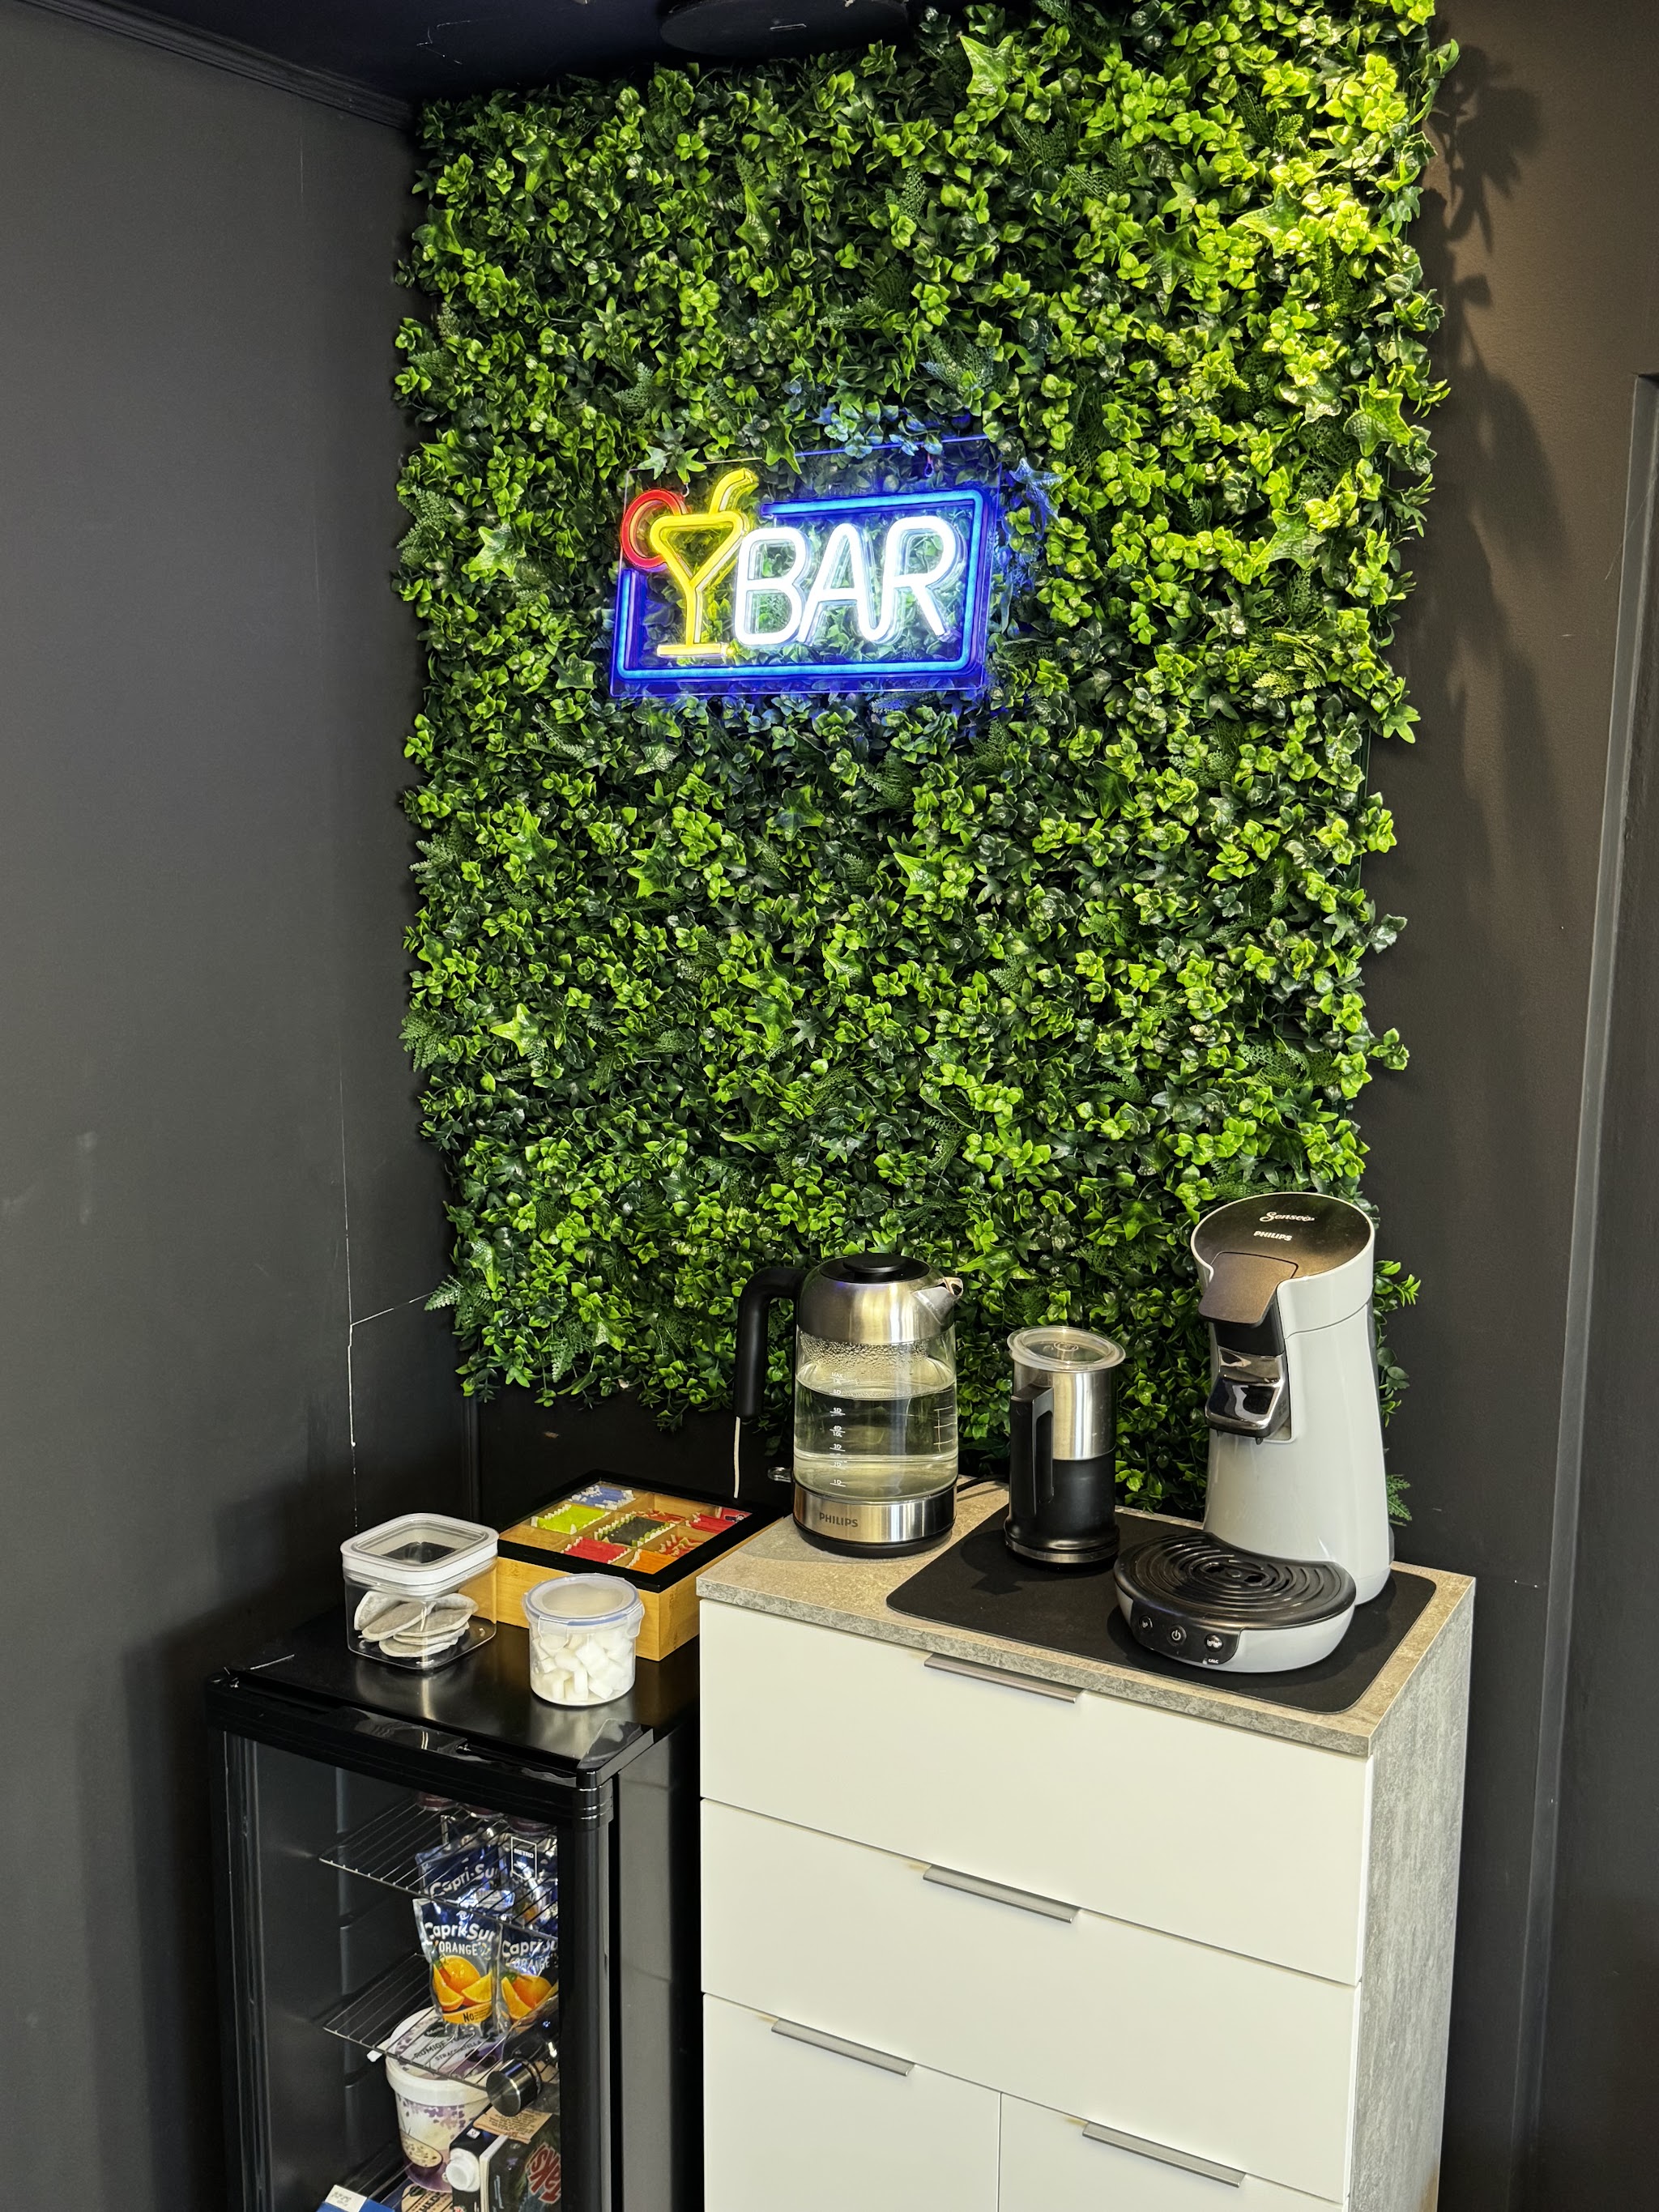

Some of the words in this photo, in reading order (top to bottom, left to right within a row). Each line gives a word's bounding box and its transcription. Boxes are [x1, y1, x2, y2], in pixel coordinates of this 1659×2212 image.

[734, 516, 957, 646] BAR
[1253, 1230, 1293, 1242] PHILIPS
[819, 1511, 859, 1528] PHILIPS
[514, 1848, 535, 1859] METRO
[438, 1941, 479, 1956] ORANGE
